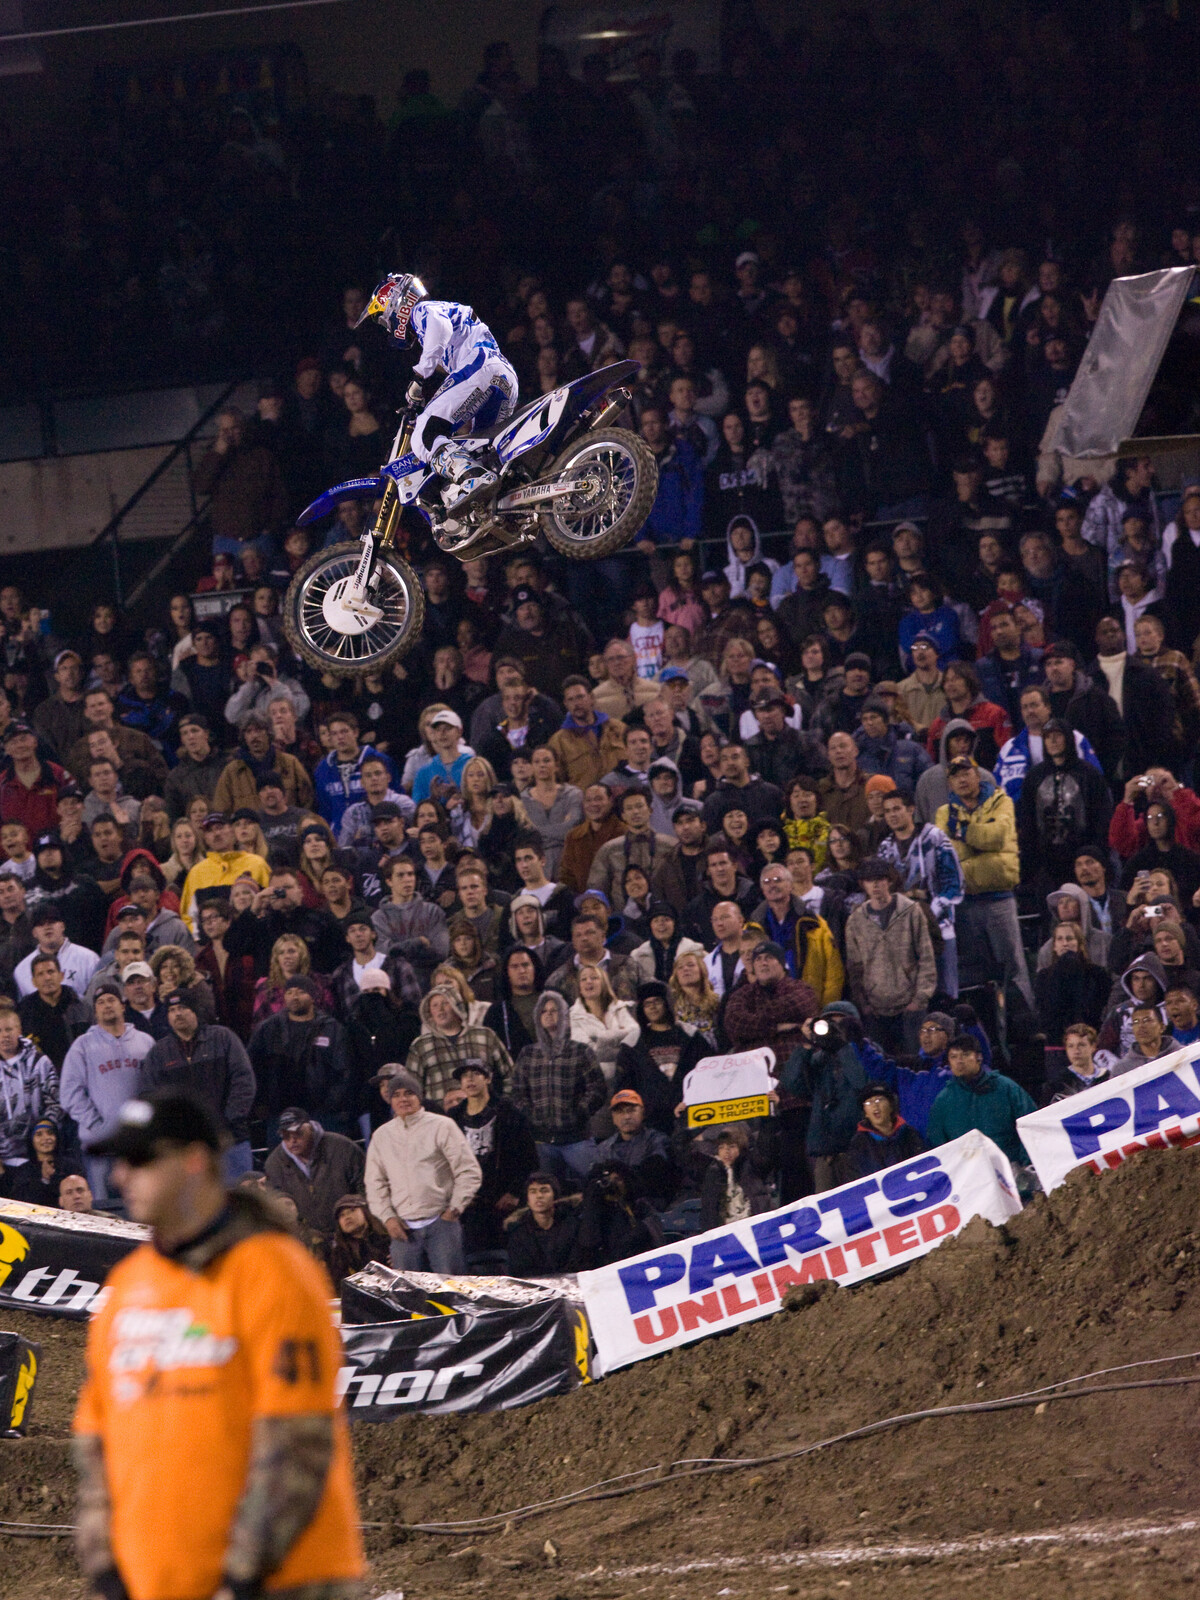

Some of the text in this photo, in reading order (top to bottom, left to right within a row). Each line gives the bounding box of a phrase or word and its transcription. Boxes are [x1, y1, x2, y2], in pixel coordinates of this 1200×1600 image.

[393, 290, 420, 340] Red Bull
[391, 458, 411, 472] SAN
[522, 485, 551, 499] YAMAHA
[99, 1059, 121, 1075] RED
[718, 1099, 765, 1112] TOYOTA
[718, 1107, 765, 1120] TRUCKS
[1060, 1058, 1200, 1160] PA
[617, 1155, 953, 1315] PARTS
[11, 1265, 115, 1314] th
[633, 1204, 961, 1345] UNLIMITED
[333, 1363, 484, 1408] hor
